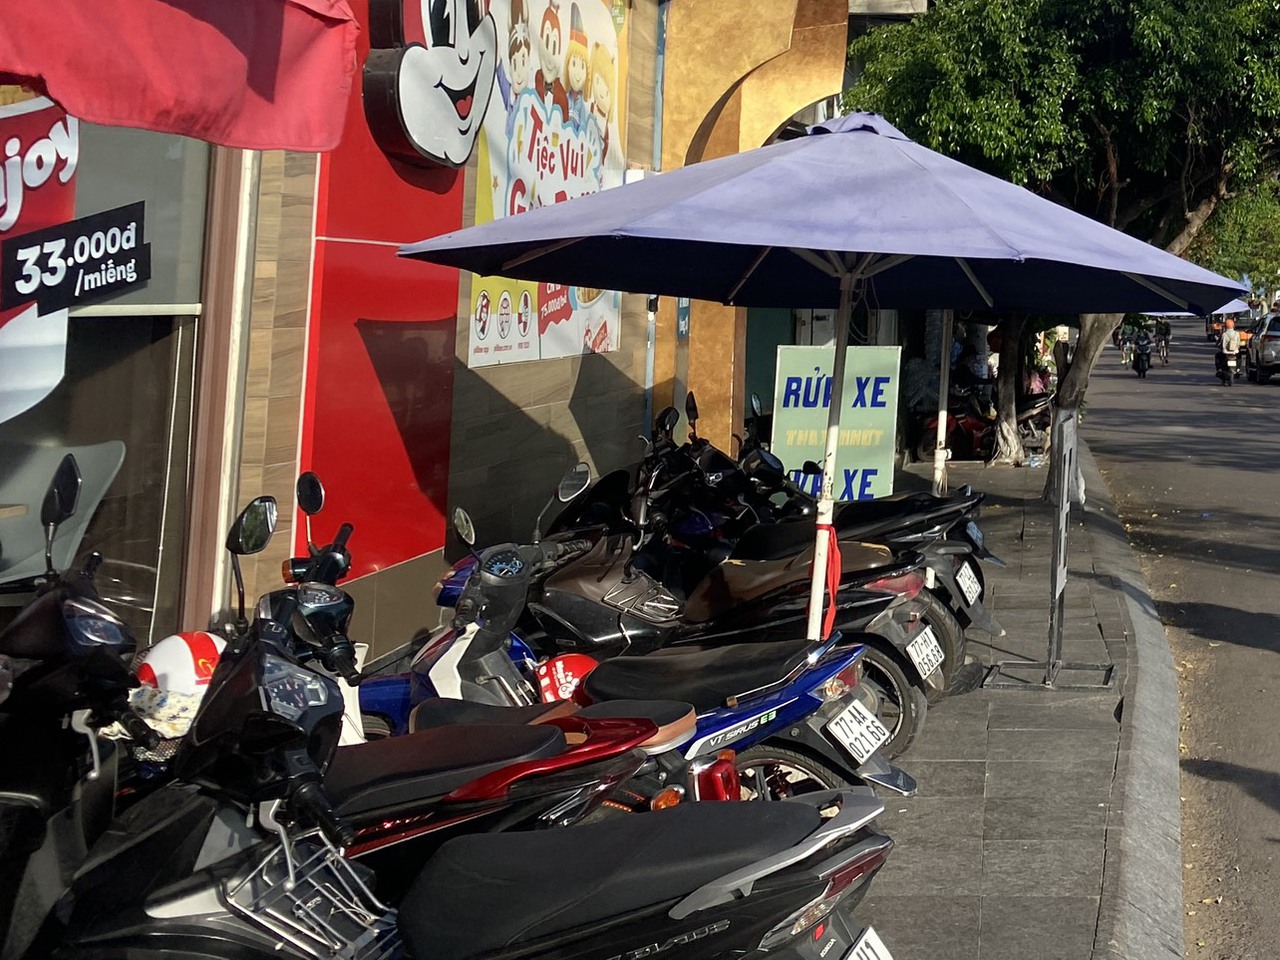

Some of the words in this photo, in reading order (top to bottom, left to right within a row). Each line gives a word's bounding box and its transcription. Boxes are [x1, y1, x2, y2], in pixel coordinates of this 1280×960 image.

[527, 103, 556, 181] Tiệc
[559, 138, 584, 182] Vui
[0, 114, 79, 232] joy
[15, 222, 137, 295] 33.000đ
[852, 376, 890, 408] XE
[839, 468, 878, 501] XE
[848, 719, 887, 759] 021.66
